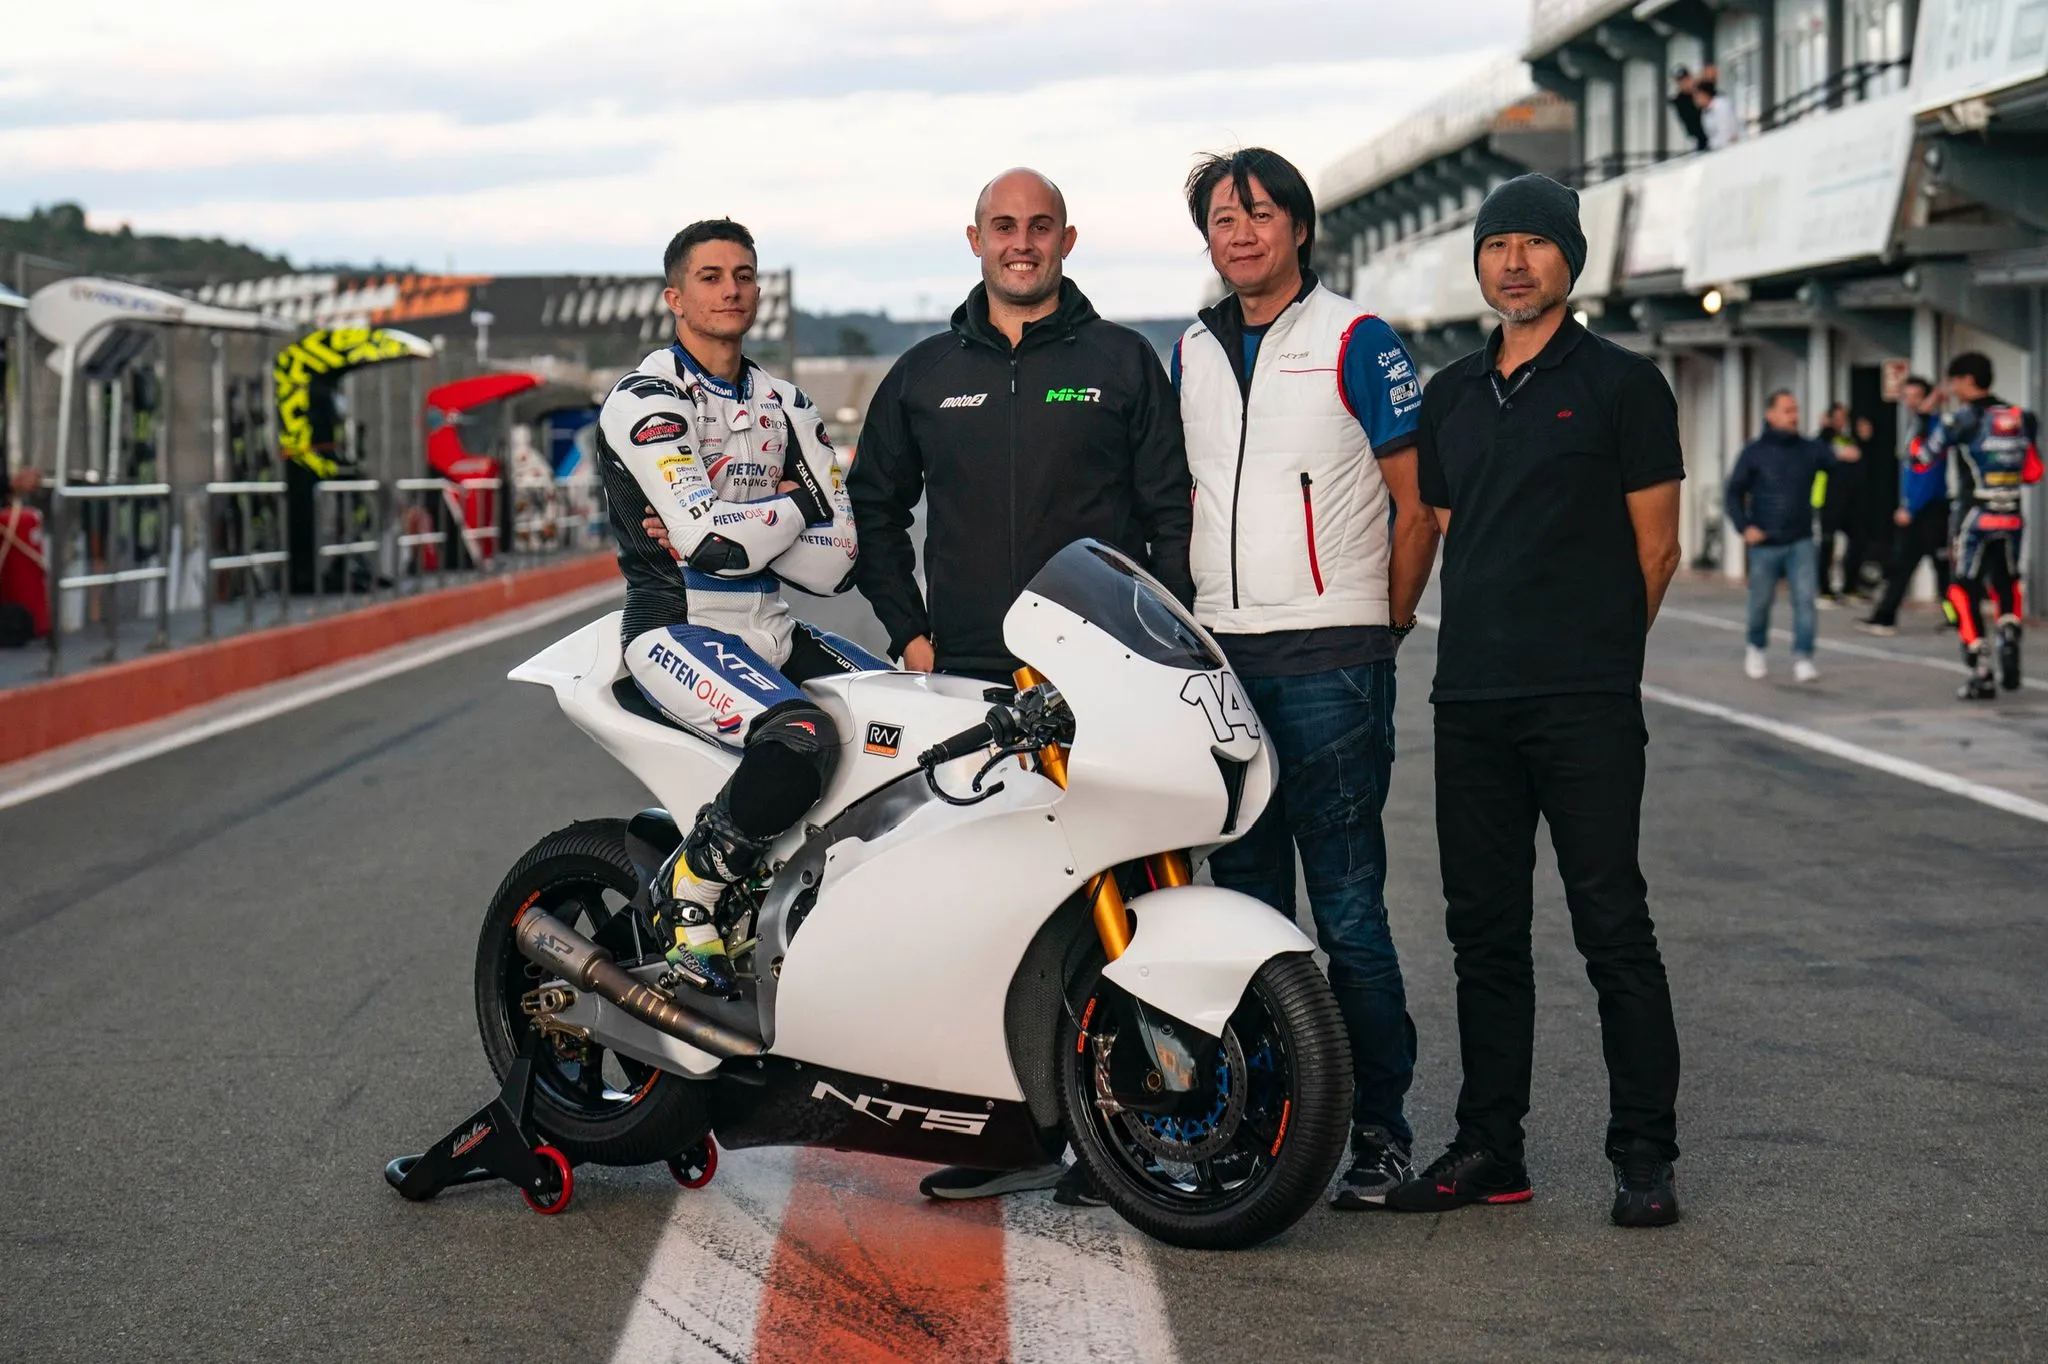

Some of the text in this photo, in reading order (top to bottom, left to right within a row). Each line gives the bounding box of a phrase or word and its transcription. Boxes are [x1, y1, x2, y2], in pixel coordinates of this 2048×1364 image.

[1046, 388, 1101, 403] MMR
[1180, 671, 1261, 743] 14
[811, 1080, 991, 1136] NTS
